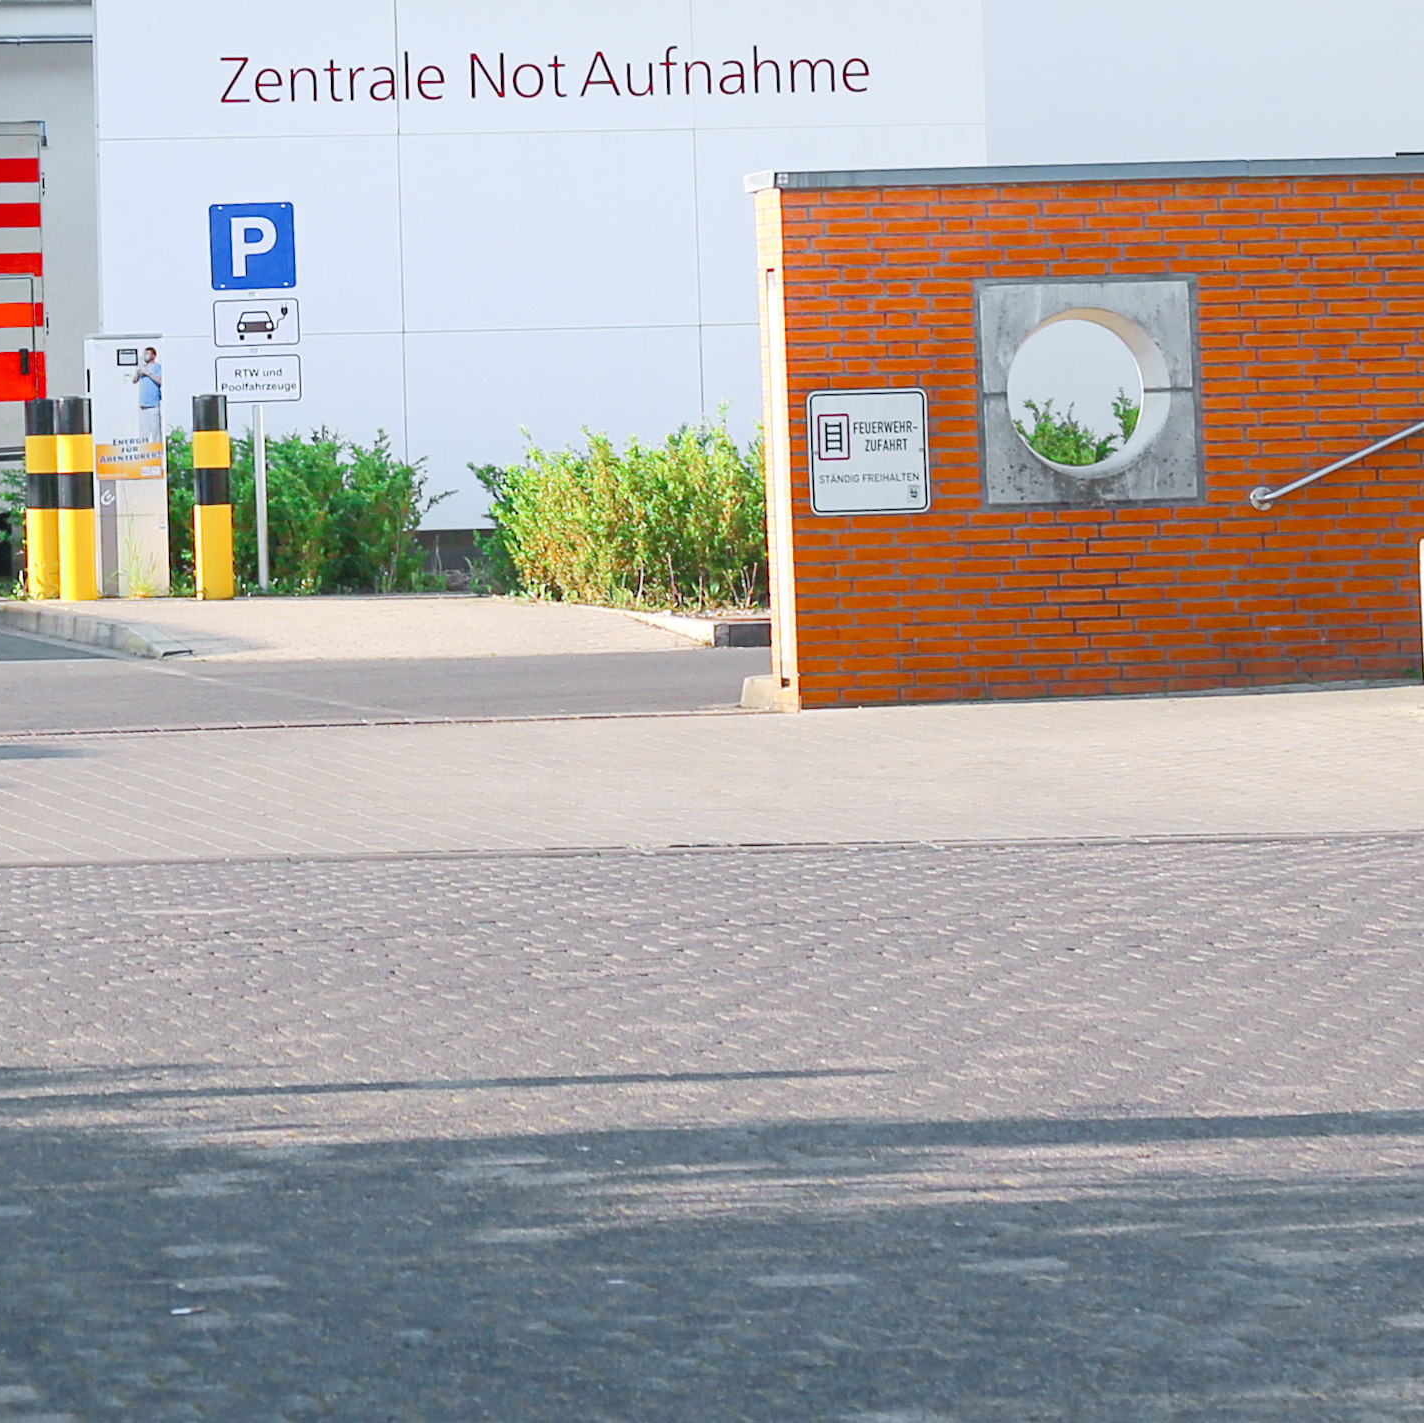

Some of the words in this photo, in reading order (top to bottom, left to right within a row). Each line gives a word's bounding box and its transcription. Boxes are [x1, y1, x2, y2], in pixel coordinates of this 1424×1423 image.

[219, 51, 446, 104] Zentrale
[469, 52, 568, 99] Not
[580, 44, 871, 97] Aufnahme
[230, 216, 278, 278] P
[234, 368, 260, 378] RTW
[262, 367, 283, 377] und
[221, 382, 297, 393] Poolfahrzeuge
[853, 421, 919, 434] FEUERWEHR-
[865, 439, 908, 452] ZUFAHRT
[819, 473, 860, 484] STÄNDIG
[862, 472, 919, 483] FREIHALTEN
